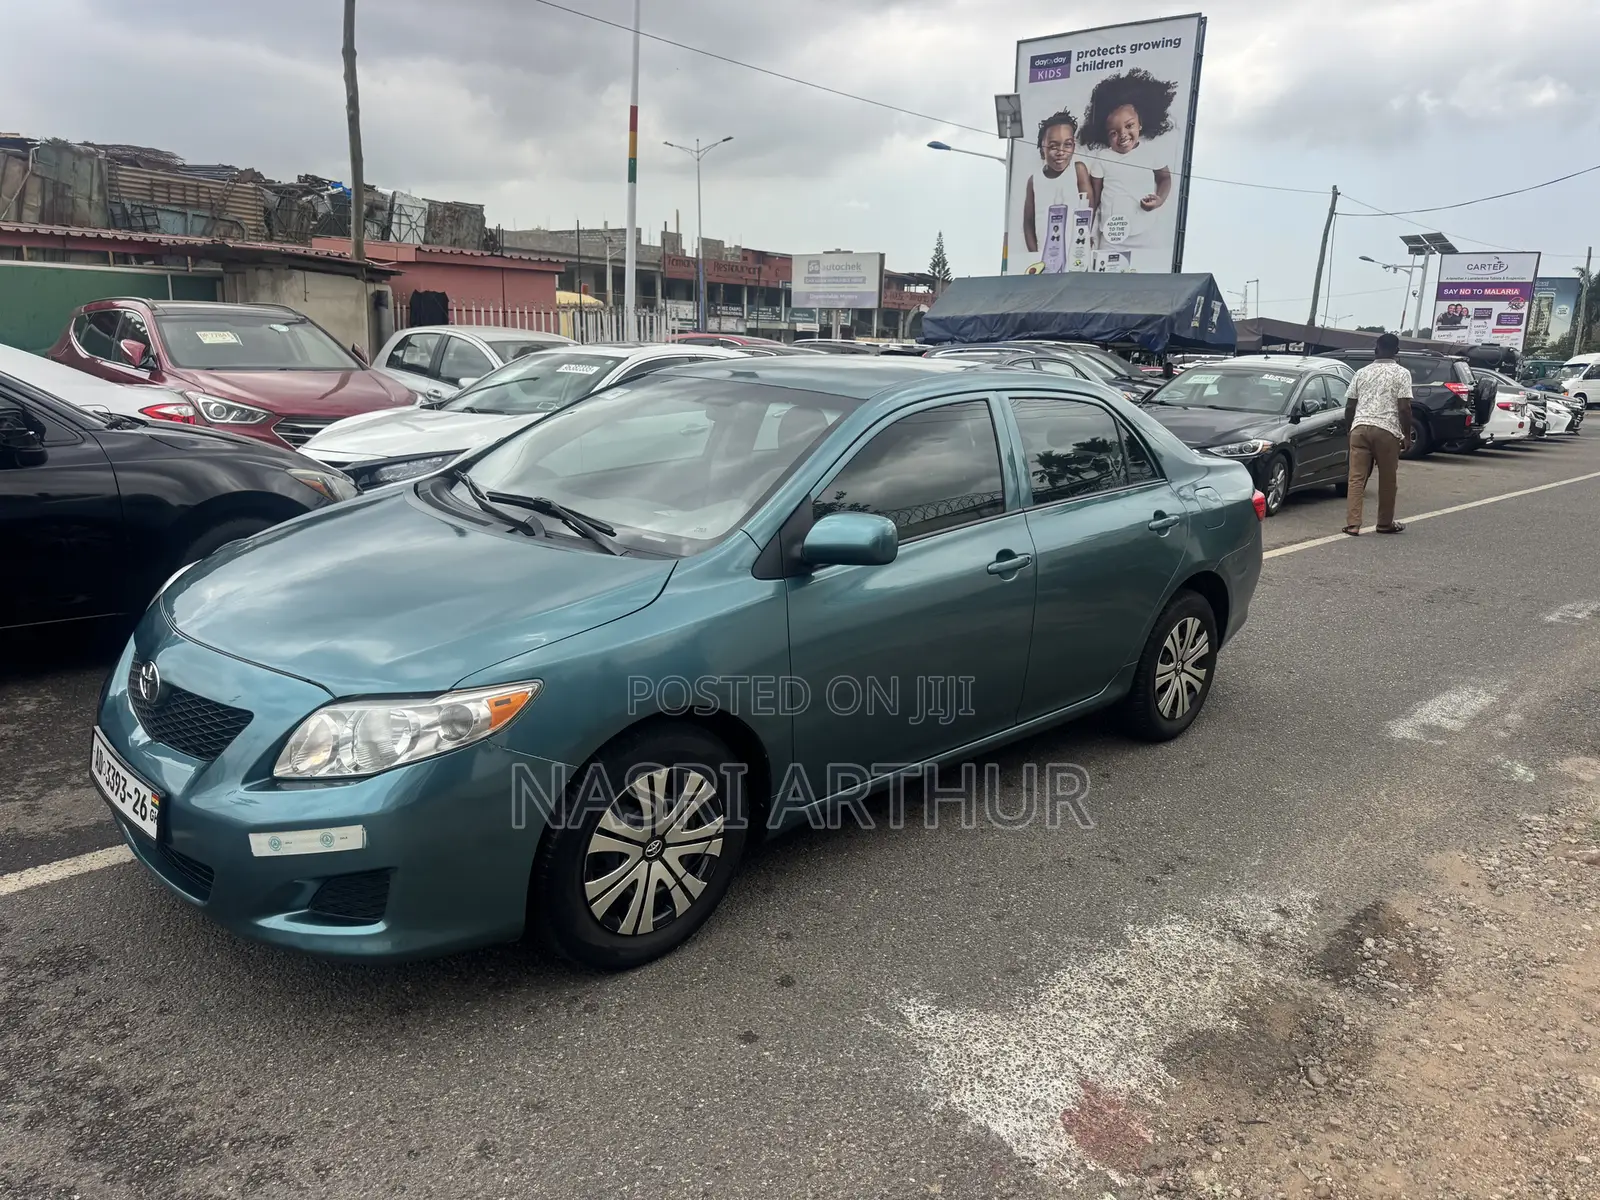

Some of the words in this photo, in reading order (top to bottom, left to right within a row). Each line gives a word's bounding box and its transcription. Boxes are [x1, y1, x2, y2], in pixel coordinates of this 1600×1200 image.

[1076, 43, 1127, 61] protects
[1130, 37, 1182, 55] growing
[1075, 58, 1124, 73] children
[1037, 68, 1062, 80] KIDS
[821, 261, 863, 271] autochek
[1466, 263, 1505, 271] CARTEF
